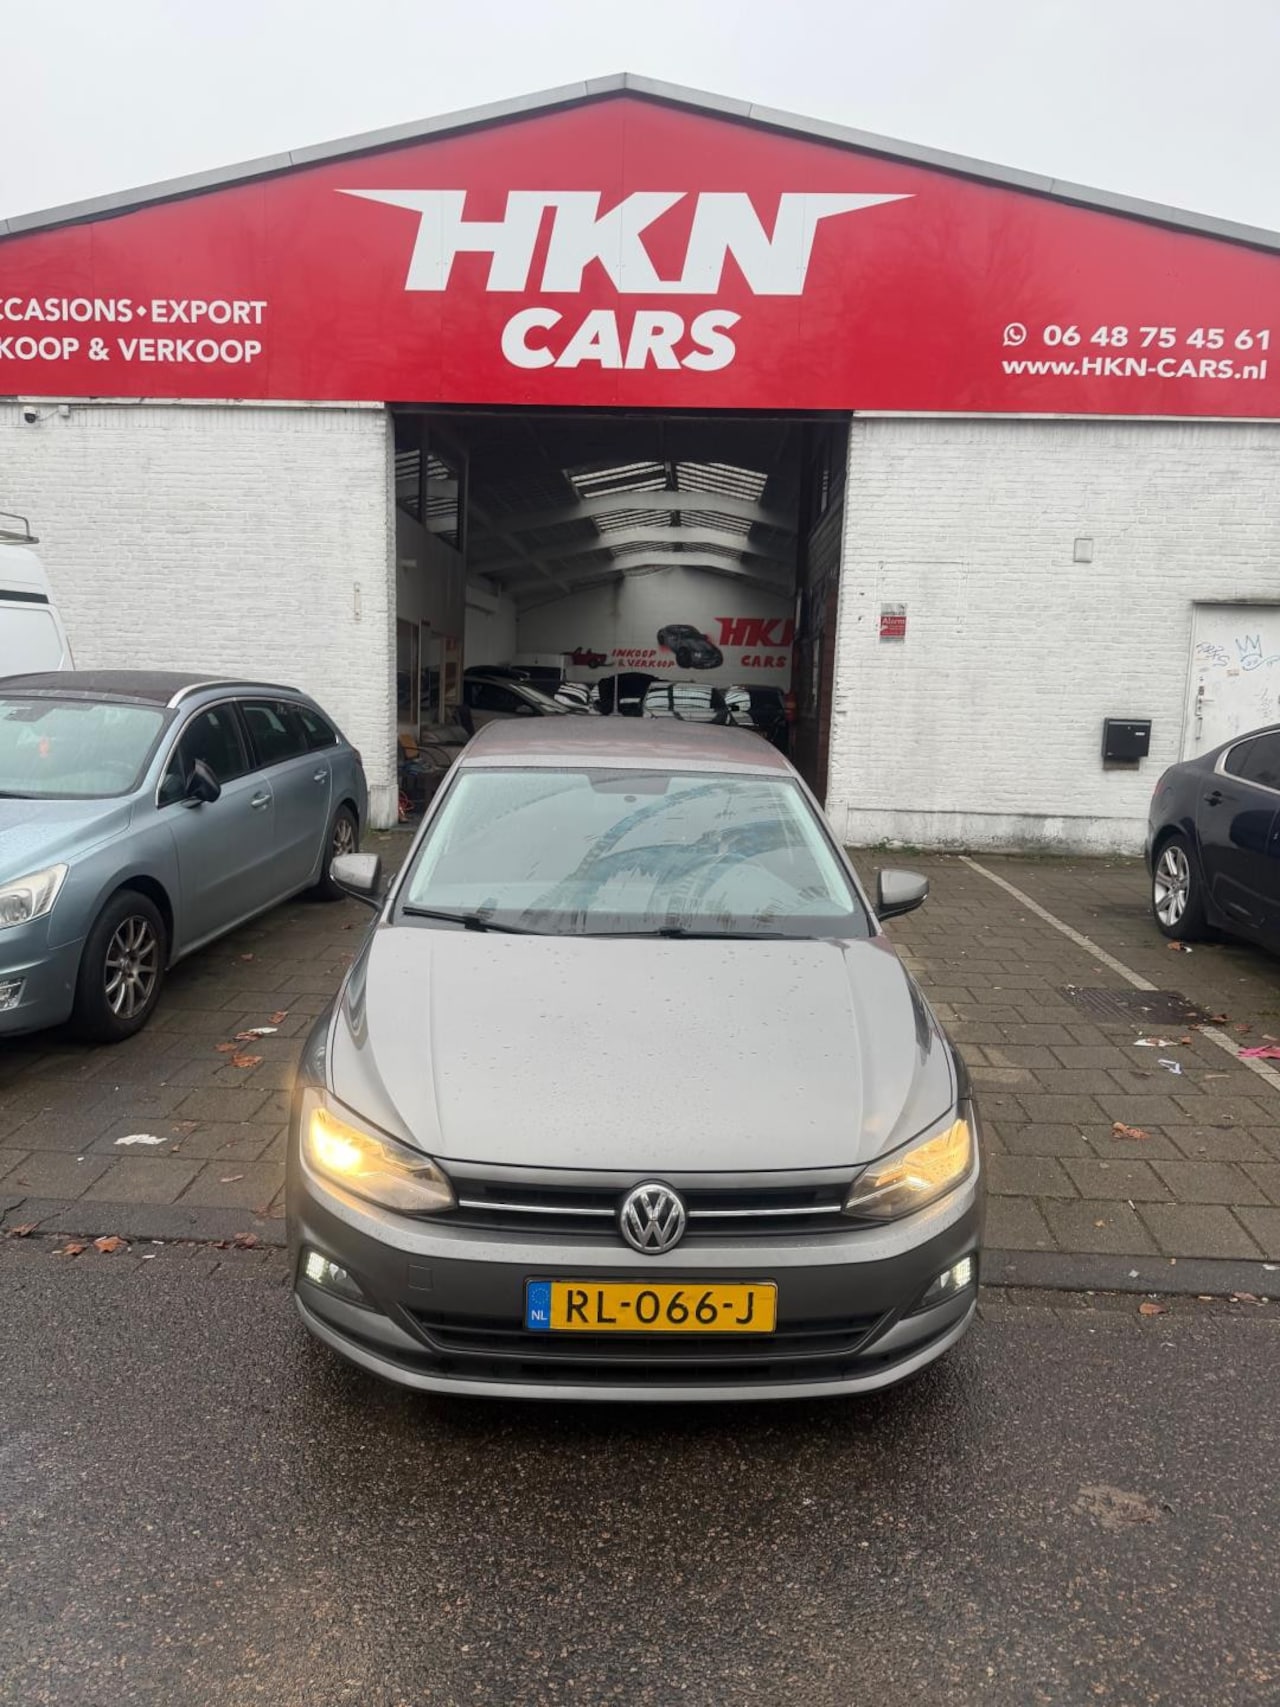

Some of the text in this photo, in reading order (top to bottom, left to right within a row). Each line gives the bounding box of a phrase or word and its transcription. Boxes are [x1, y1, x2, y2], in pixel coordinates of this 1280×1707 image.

[333, 188, 918, 296] HKN
[0, 297, 268, 325] CASIONS EXPORT
[88, 337, 111, 362] &
[117, 338, 262, 364] VERKOOP
[500, 307, 743, 372] CARS
[1042, 325, 1271, 351] 06 48 75 45 61
[1001, 357, 1268, 380] www.HKN-CARS.nl
[612, 648, 657, 658] INKOOP
[627, 659, 675, 668] VERKOOP
[741, 655, 787, 668] CARS
[531, 1311, 548, 1321] NL
[566, 1289, 755, 1325] RL-066-J
